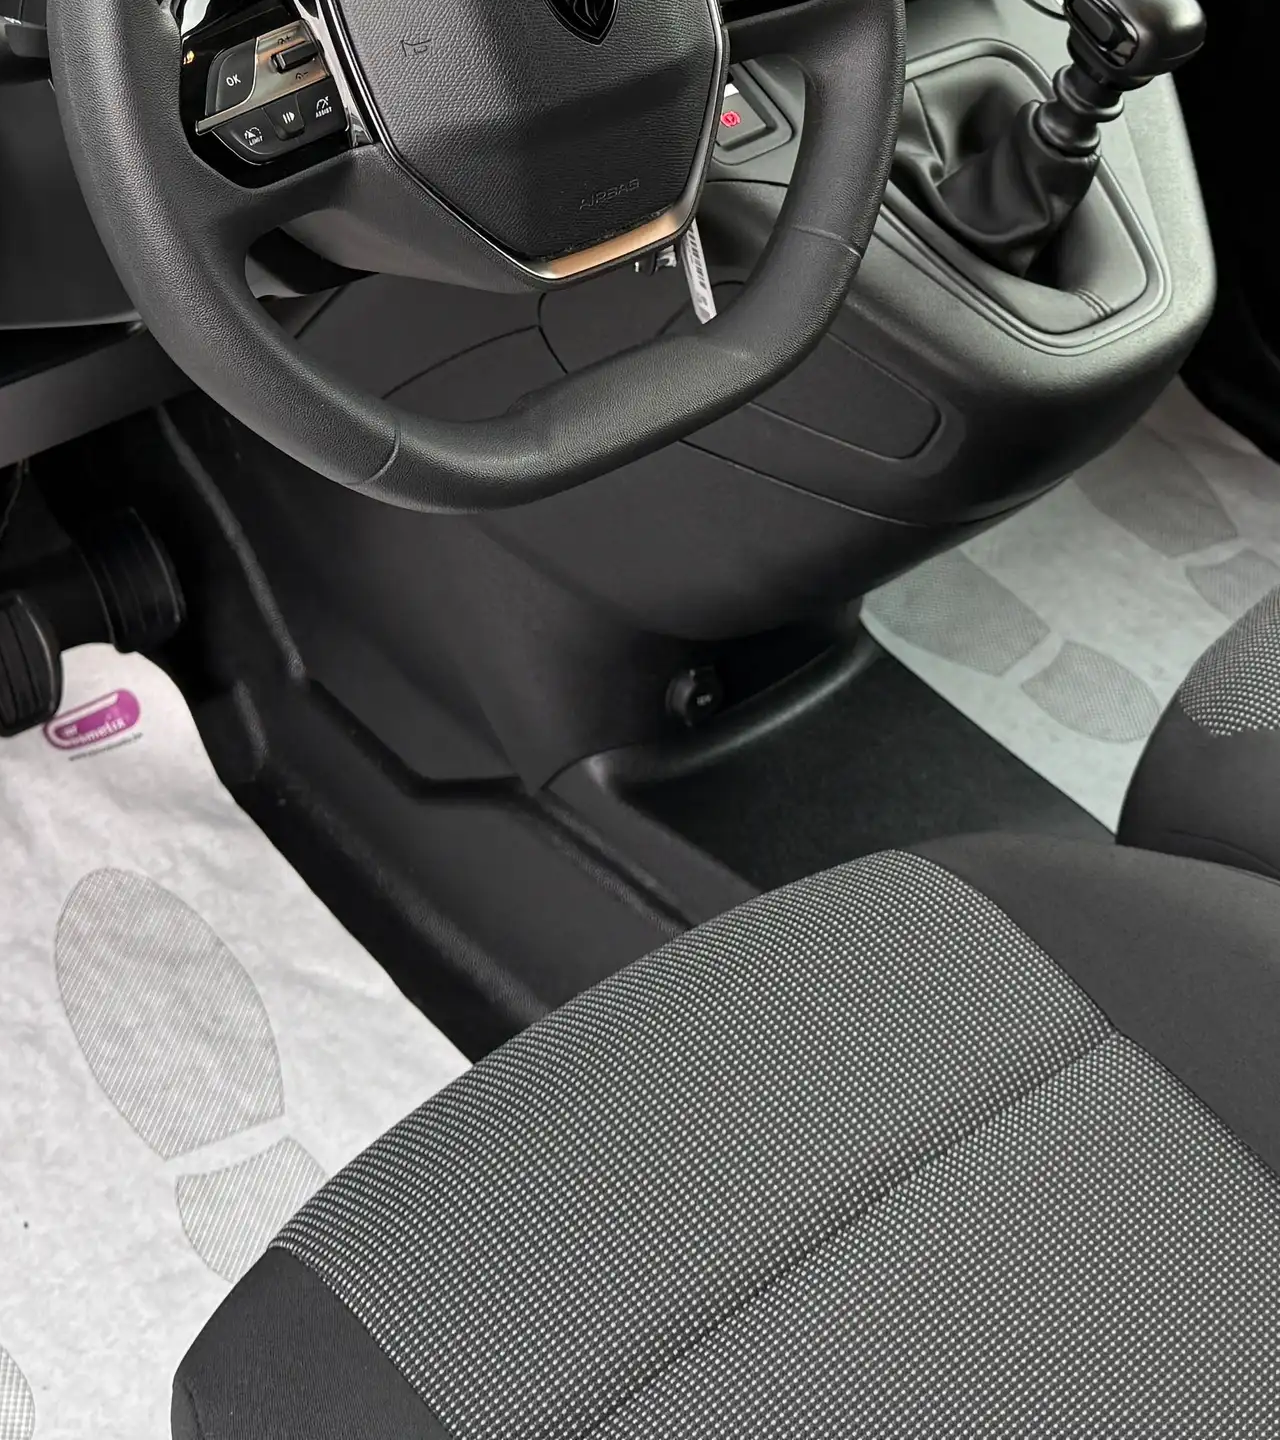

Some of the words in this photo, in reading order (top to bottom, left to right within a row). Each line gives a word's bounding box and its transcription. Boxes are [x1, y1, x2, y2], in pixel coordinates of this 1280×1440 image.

[226, 74, 242, 87] OK
[315, 106, 332, 119] ASSIST
[249, 135, 263, 146] LIMIT
[580, 177, 640, 210] AIRBAG
